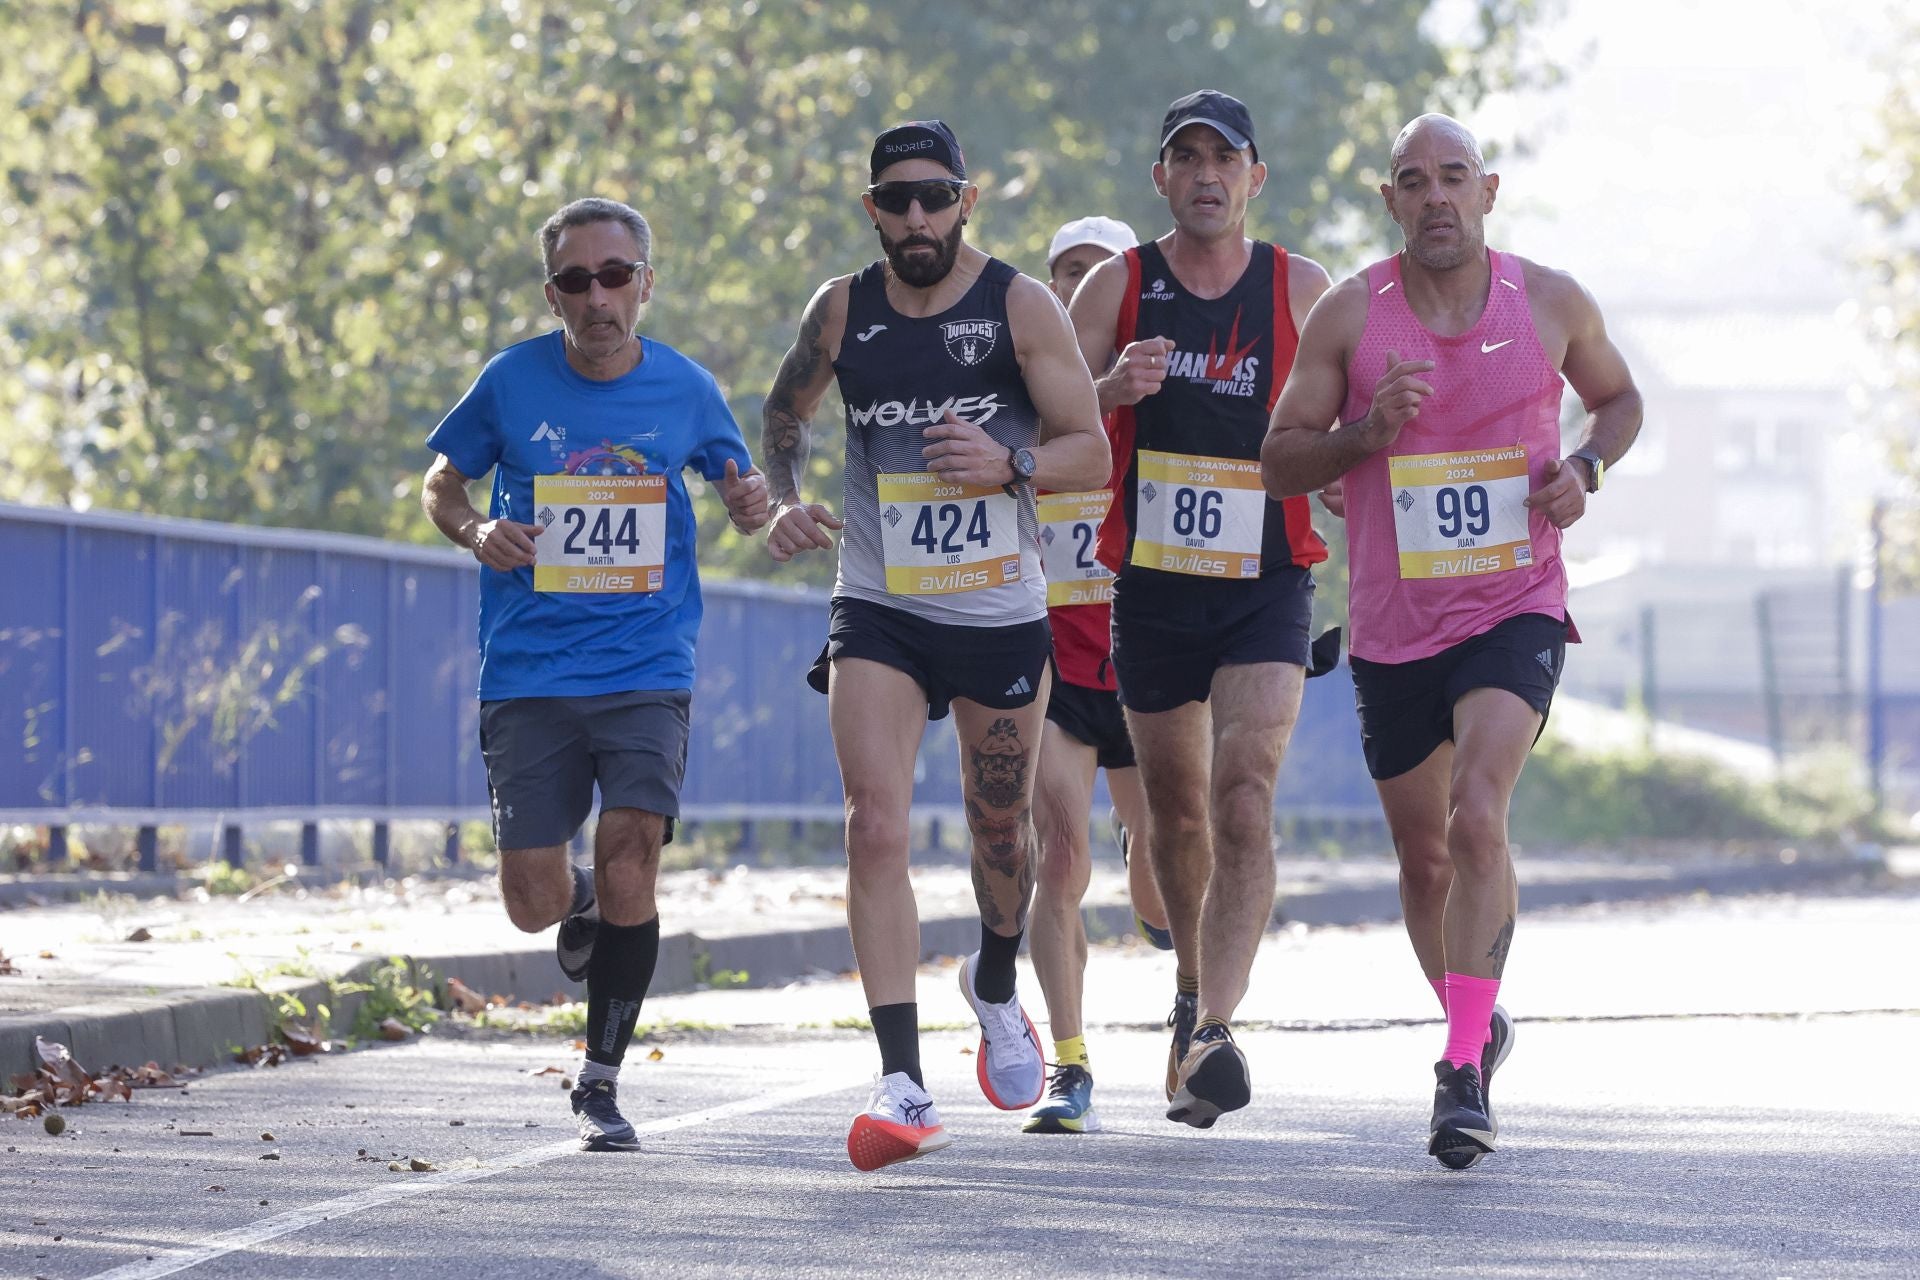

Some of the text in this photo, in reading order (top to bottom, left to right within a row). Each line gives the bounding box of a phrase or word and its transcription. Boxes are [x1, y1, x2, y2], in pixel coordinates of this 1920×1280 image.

[885, 140, 933, 153] SUNDRIED
[1142, 292, 1174, 300] VIATOR
[946, 322, 993, 339] WOLVES
[1212, 380, 1255, 397] AVILES
[850, 393, 1003, 426] WOLVES
[1420, 459, 1448, 467] MEDIA
[1450, 453, 1495, 465] MARATÓN
[1497, 449, 1525, 460] AVILÉS
[1166, 458, 1191, 467] MEDIA
[1193, 460, 1236, 471] MARATÓN
[1188, 472, 1215, 482] 2024
[1446, 469, 1475, 479] 2024
[564, 479, 590, 487] MEDIA
[592, 477, 635, 487] MARATÓN
[637, 478, 664, 487] AVILÉS
[908, 475, 936, 484] MEDIA
[587, 491, 615, 500] 2024
[934, 487, 963, 497] 2024
[1080, 505, 1105, 515] 2024
[1173, 487, 1223, 538] 86
[1436, 485, 1490, 538] 99
[563, 507, 640, 555] 244
[911, 500, 991, 553] 424
[1072, 522, 1102, 568] 2
[1185, 538, 1205, 548] DAVID
[1457, 538, 1475, 548] JUAN
[587, 555, 614, 565] MARTÍN
[947, 554, 961, 564] LOS
[1086, 569, 1109, 578] CARLOS
